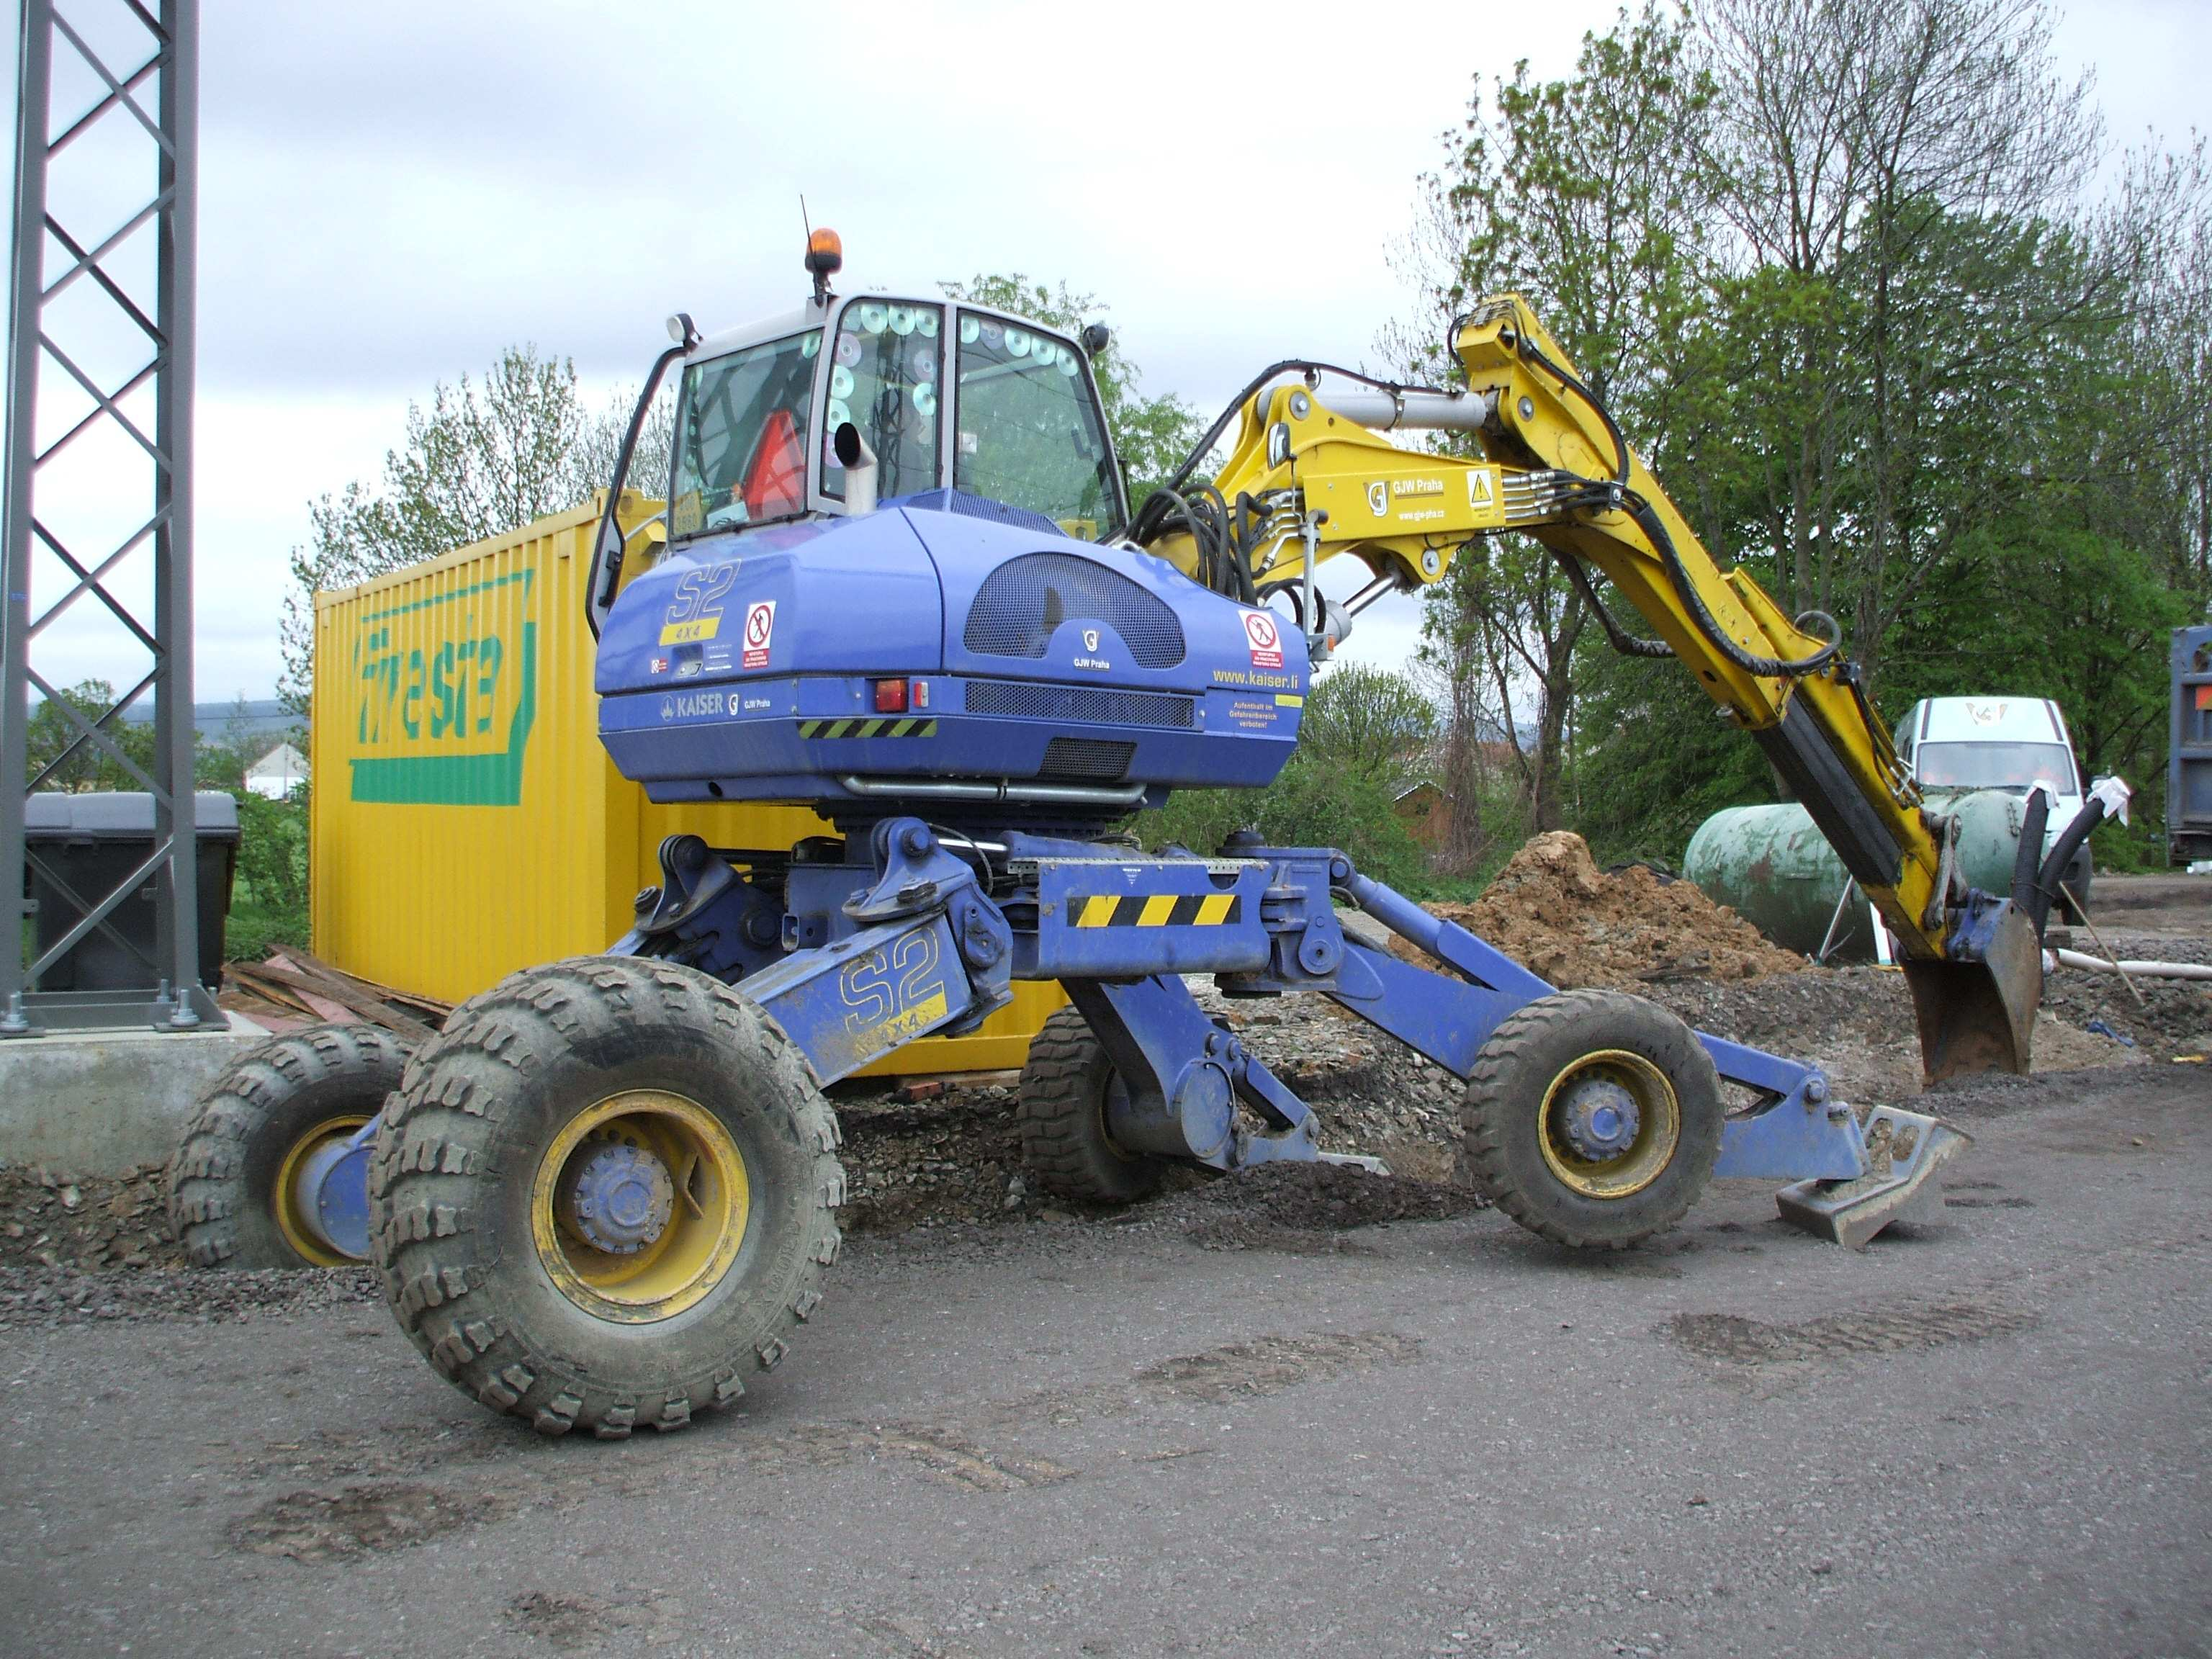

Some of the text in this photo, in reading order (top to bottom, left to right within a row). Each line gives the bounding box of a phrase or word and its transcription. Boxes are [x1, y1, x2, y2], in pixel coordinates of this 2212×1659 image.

[1393, 480, 1416, 494] GJW
[1416, 479, 1444, 493] Praha
[667, 558, 742, 626] S2
[1074, 657, 1110, 670] GJW Praha
[1213, 670, 1299, 690] www.kaiser.li
[677, 692, 724, 717] KAISER
[756, 698, 770, 709] Praha
[1233, 701, 1264, 711] Aufenthalt
[840, 927, 944, 1035] S2
